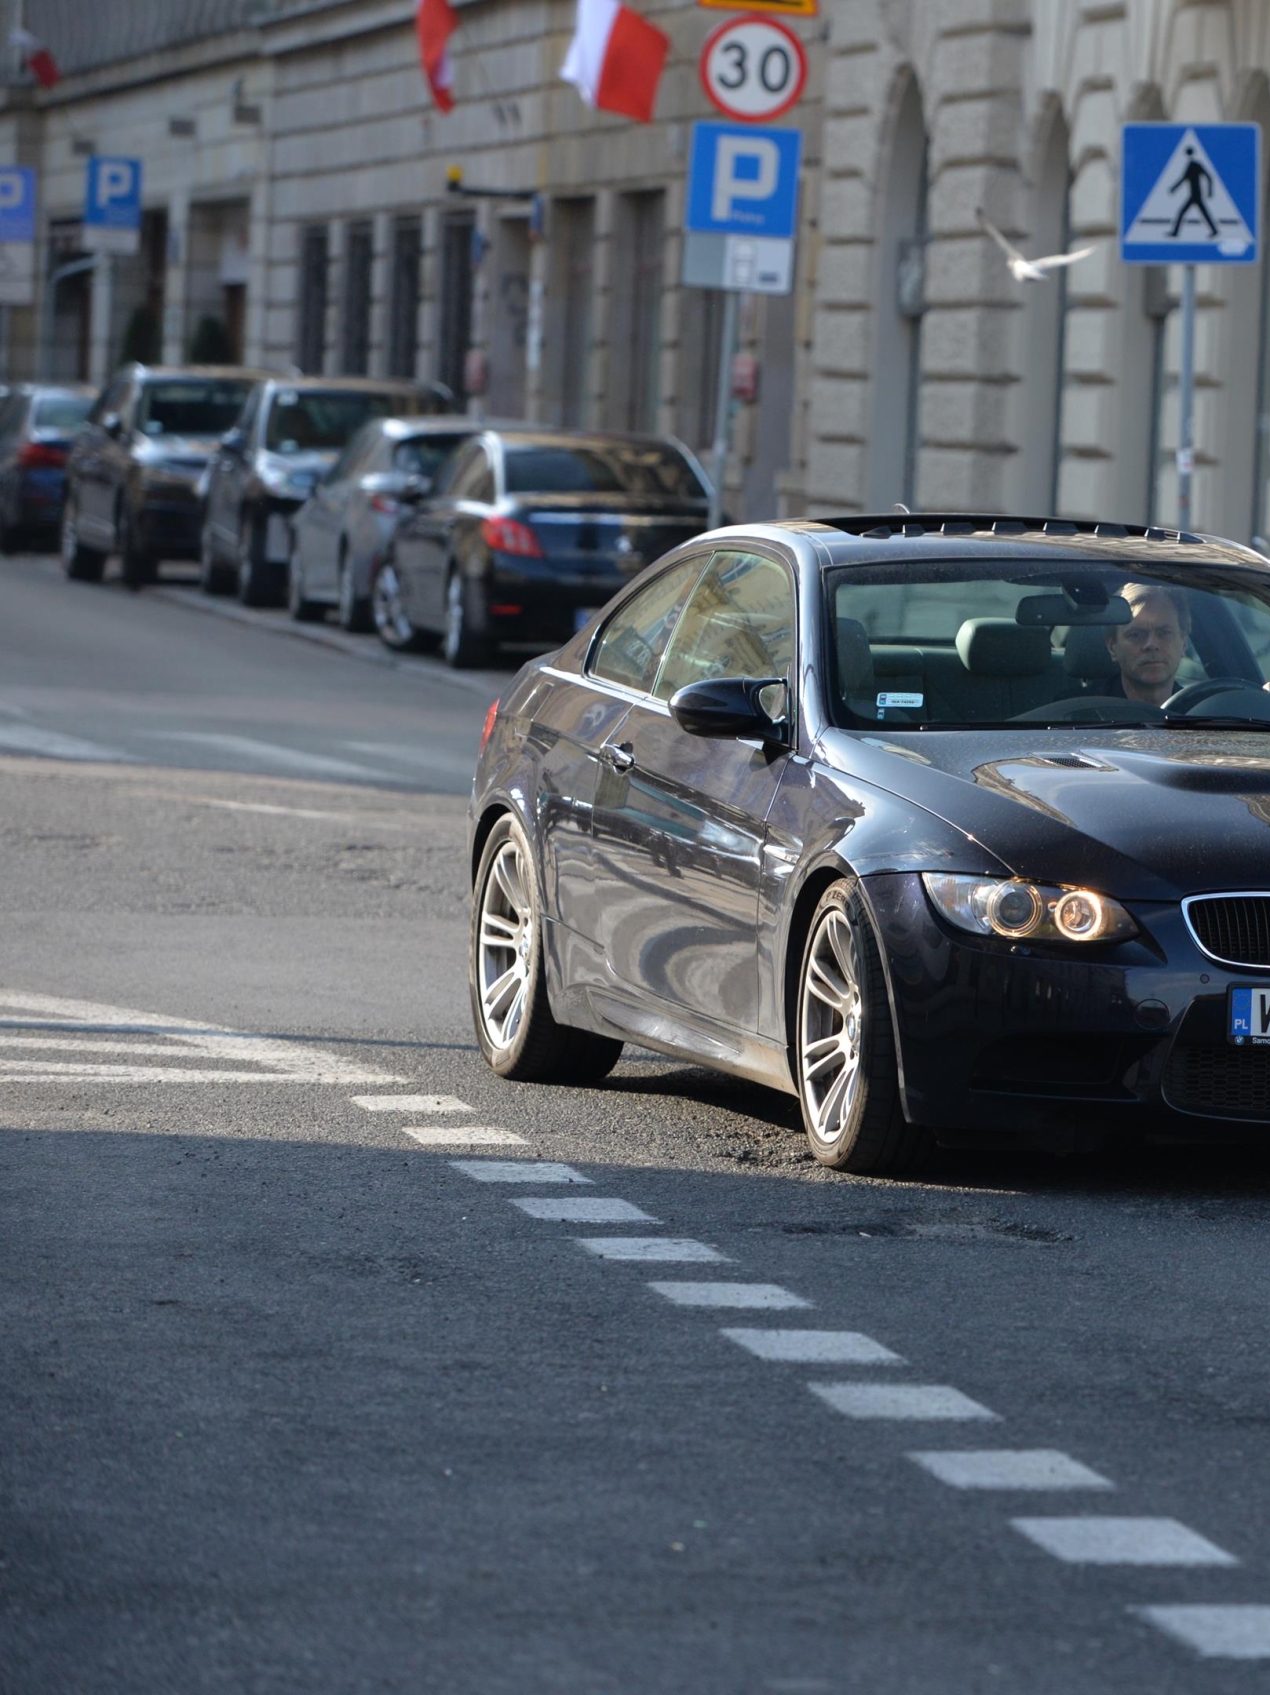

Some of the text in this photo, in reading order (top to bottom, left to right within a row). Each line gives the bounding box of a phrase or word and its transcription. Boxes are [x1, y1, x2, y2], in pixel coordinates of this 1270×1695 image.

[718, 41, 790, 93] 30
[711, 134, 780, 222] P
[1234, 1019, 1248, 1030] PL
